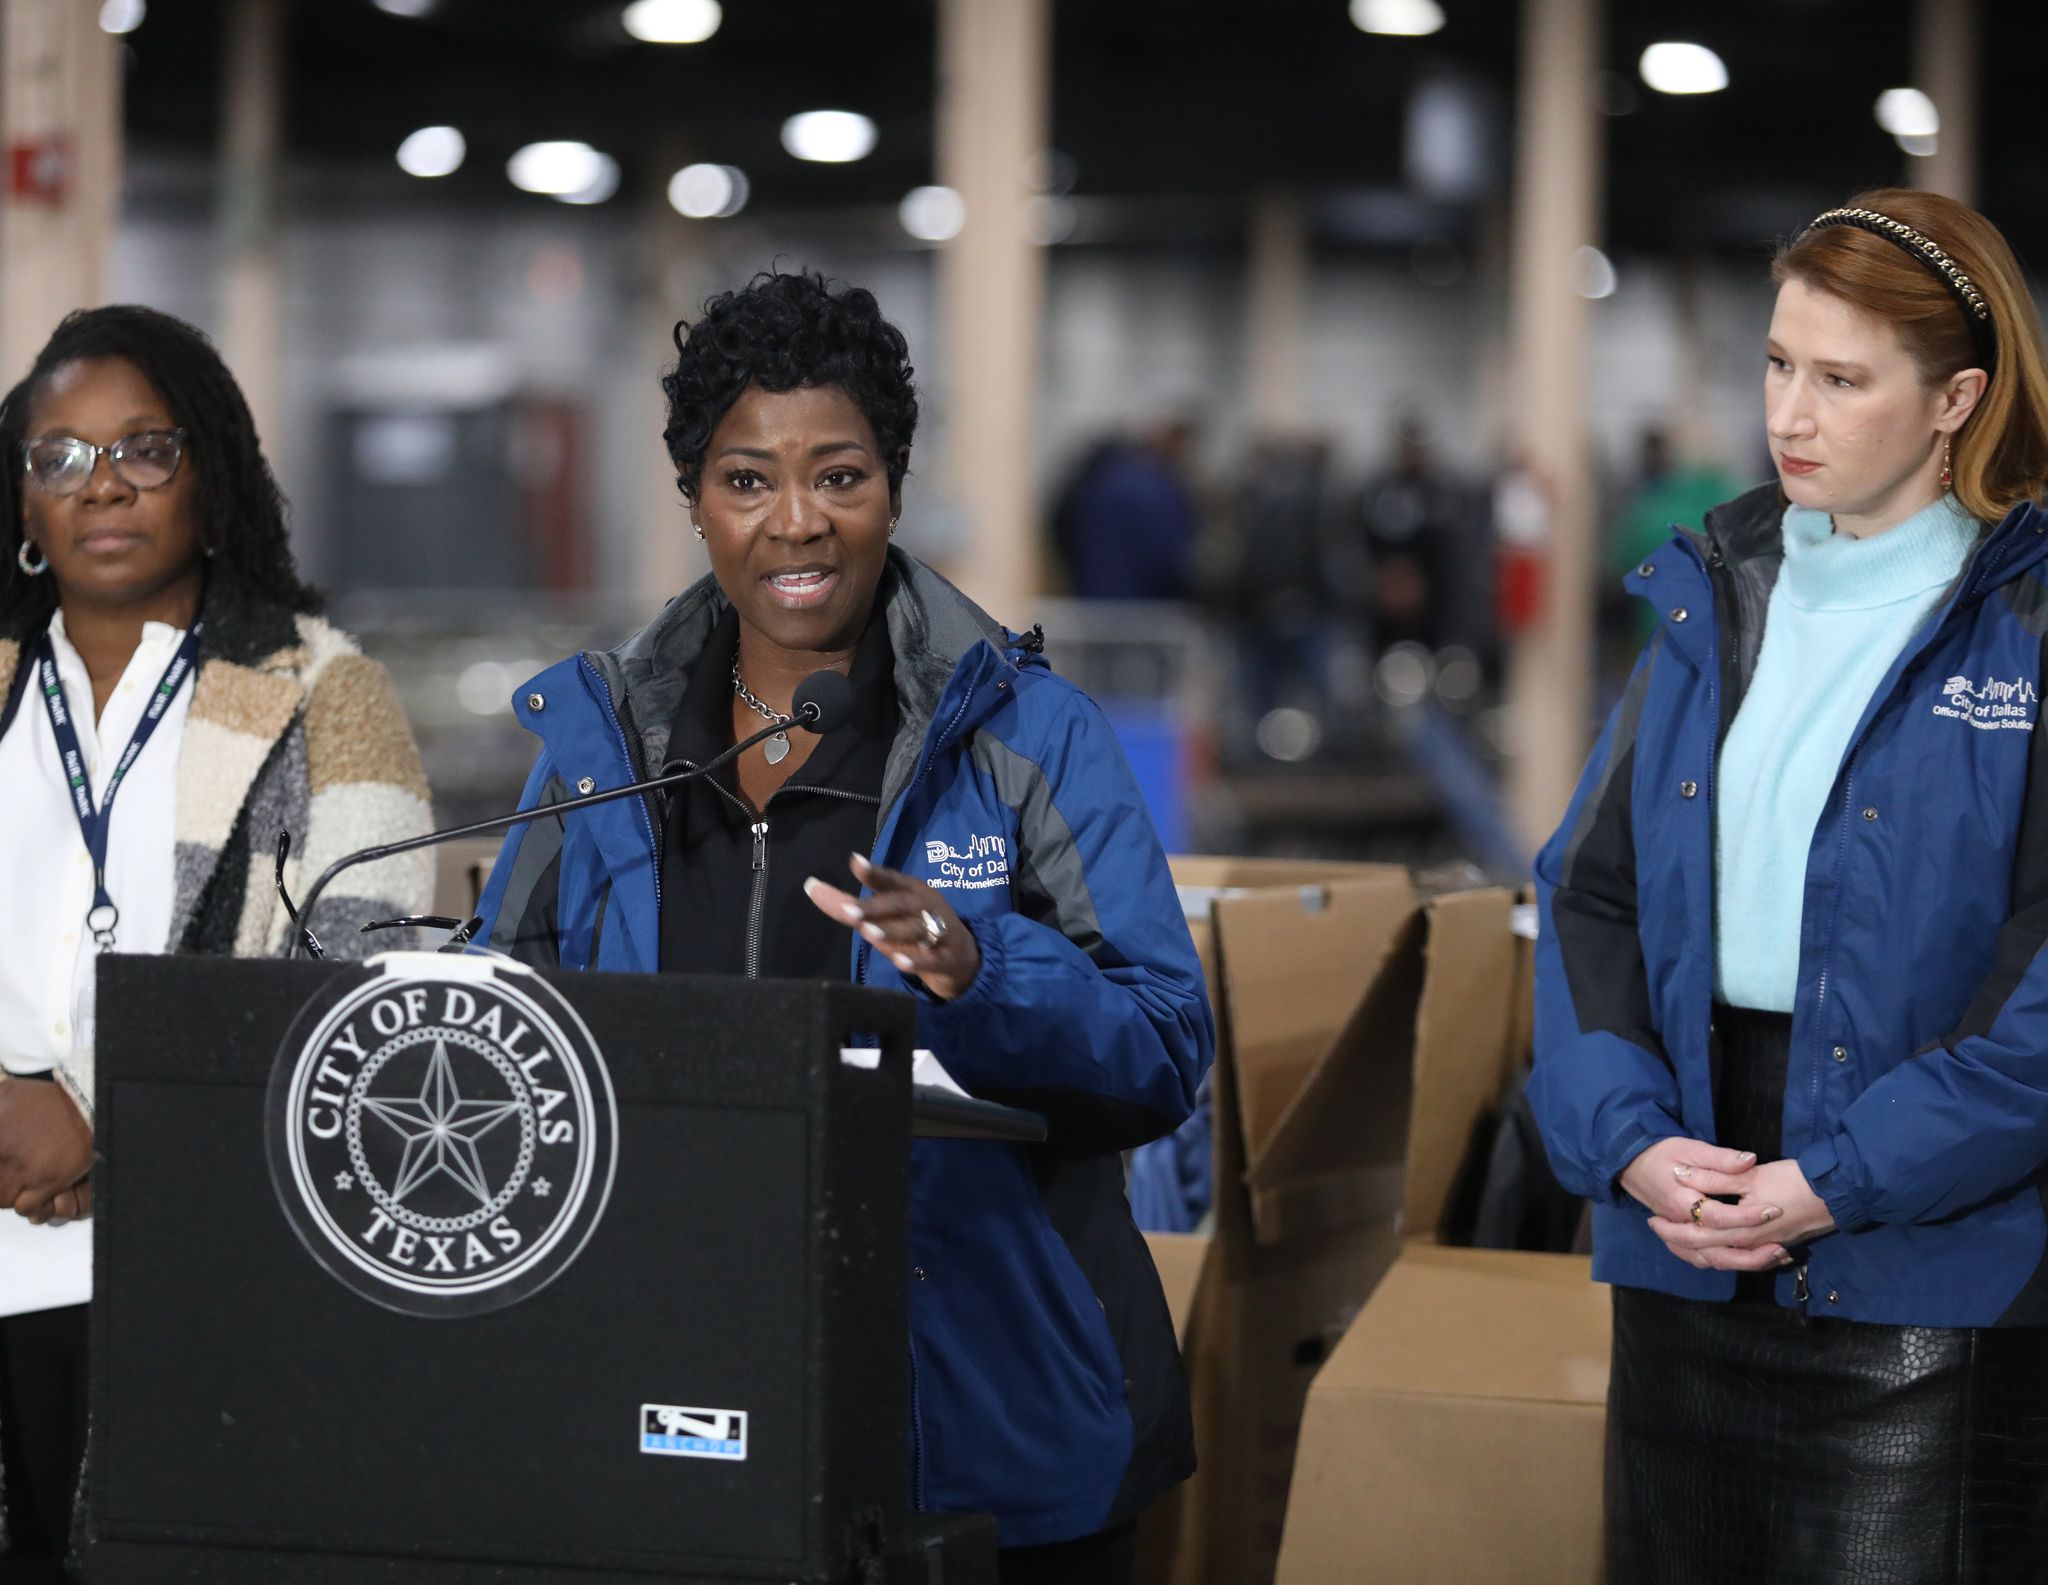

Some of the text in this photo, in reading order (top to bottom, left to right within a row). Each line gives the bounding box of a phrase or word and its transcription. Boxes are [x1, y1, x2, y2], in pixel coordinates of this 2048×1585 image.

[1951, 694, 2027, 717] City of Dallas
[1932, 705, 1959, 719] Office
[1960, 711, 1970, 721] of
[2001, 719, 2034, 731] Solution
[941, 858, 1008, 879] City of Dal
[927, 878, 953, 888] Office
[954, 879, 961, 888] of
[962, 877, 1005, 889] Homeless
[307, 988, 574, 1145] CITY OF DALLAS
[360, 1207, 522, 1272] TEXAS
